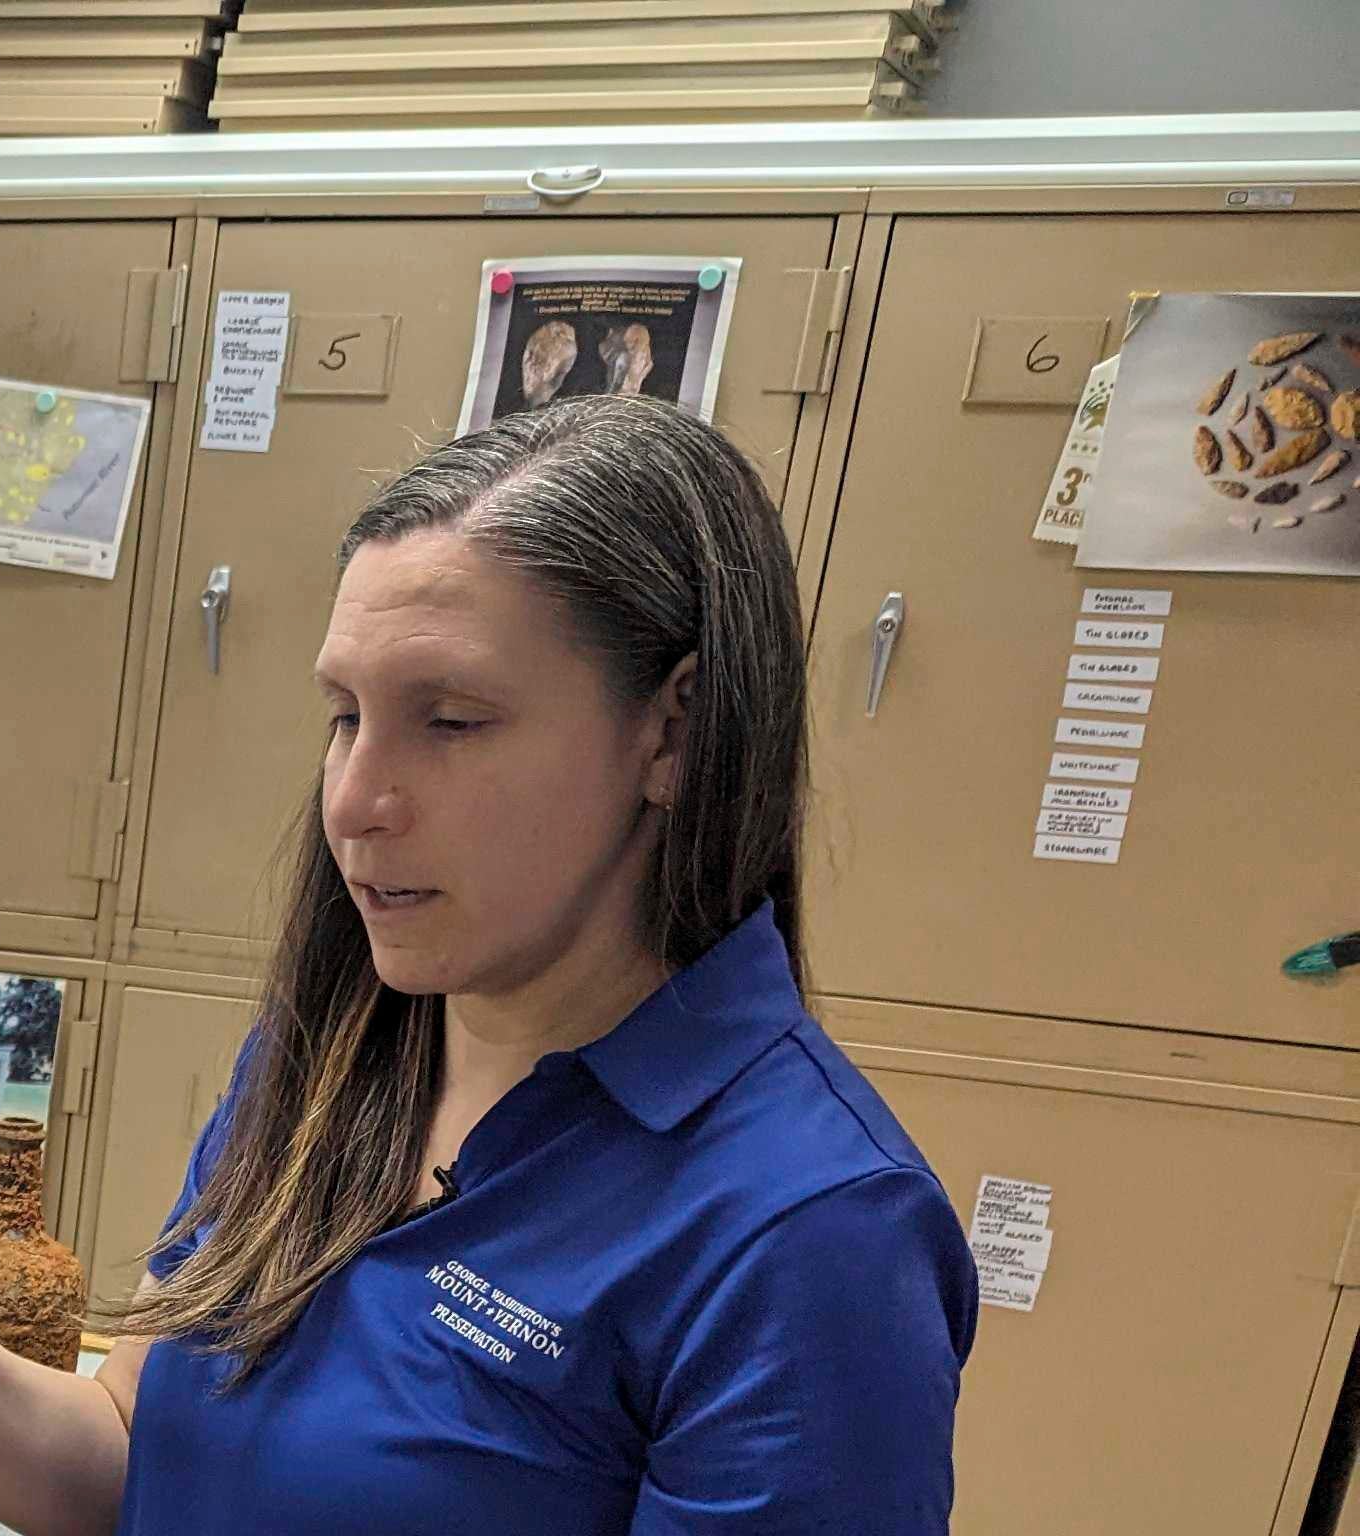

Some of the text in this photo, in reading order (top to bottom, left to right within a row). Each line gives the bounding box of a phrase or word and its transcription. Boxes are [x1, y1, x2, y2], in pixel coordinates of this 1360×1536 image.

[318, 331, 361, 371] 5
[1026, 333, 1060, 373] 6
[98, 452, 121, 479] River
[1056, 466, 1092, 507] 3r
[1043, 507, 1083, 527] PLAC
[1085, 628, 1102, 638] TIN
[1044, 843, 1109, 856] STONEWARE
[424, 1263, 566, 1360] MOUNT VERNON
[446, 1259, 564, 1338] GEORGE WASHINGTON'S
[429, 1301, 518, 1365] PRESERVATION
